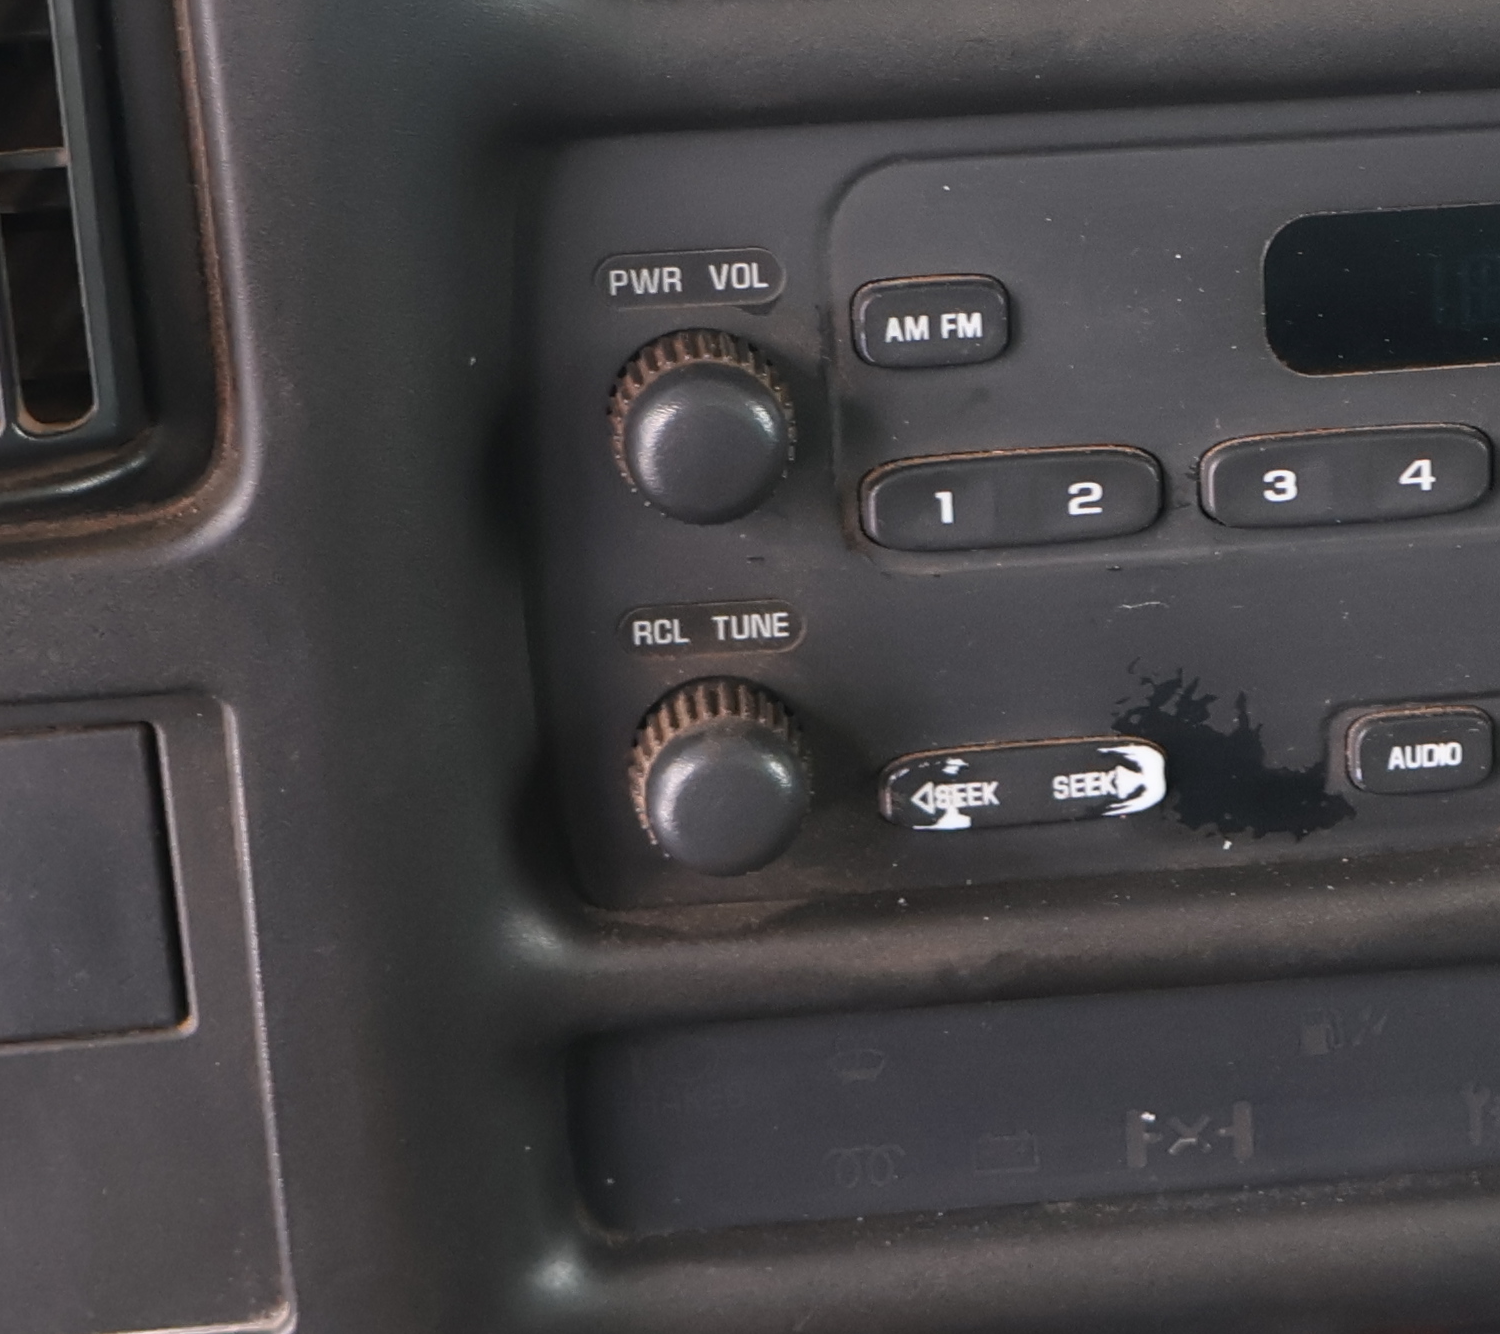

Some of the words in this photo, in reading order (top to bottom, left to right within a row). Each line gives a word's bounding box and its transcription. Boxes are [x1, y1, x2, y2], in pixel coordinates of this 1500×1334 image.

[609, 266, 683, 296] PWR
[708, 262, 769, 291] VOL
[884, 315, 930, 343] AM
[940, 312, 983, 339] FM
[1263, 469, 1298, 502] 3
[1399, 459, 1436, 491] 4
[934, 491, 955, 524] 1
[1067, 482, 1103, 515] 2
[633, 618, 690, 646] RCL
[711, 612, 790, 641] TUNE
[1388, 741, 1462, 770] AUDIO
[933, 781, 1000, 809] SEEK
[1052, 772, 1117, 800] SEEK
